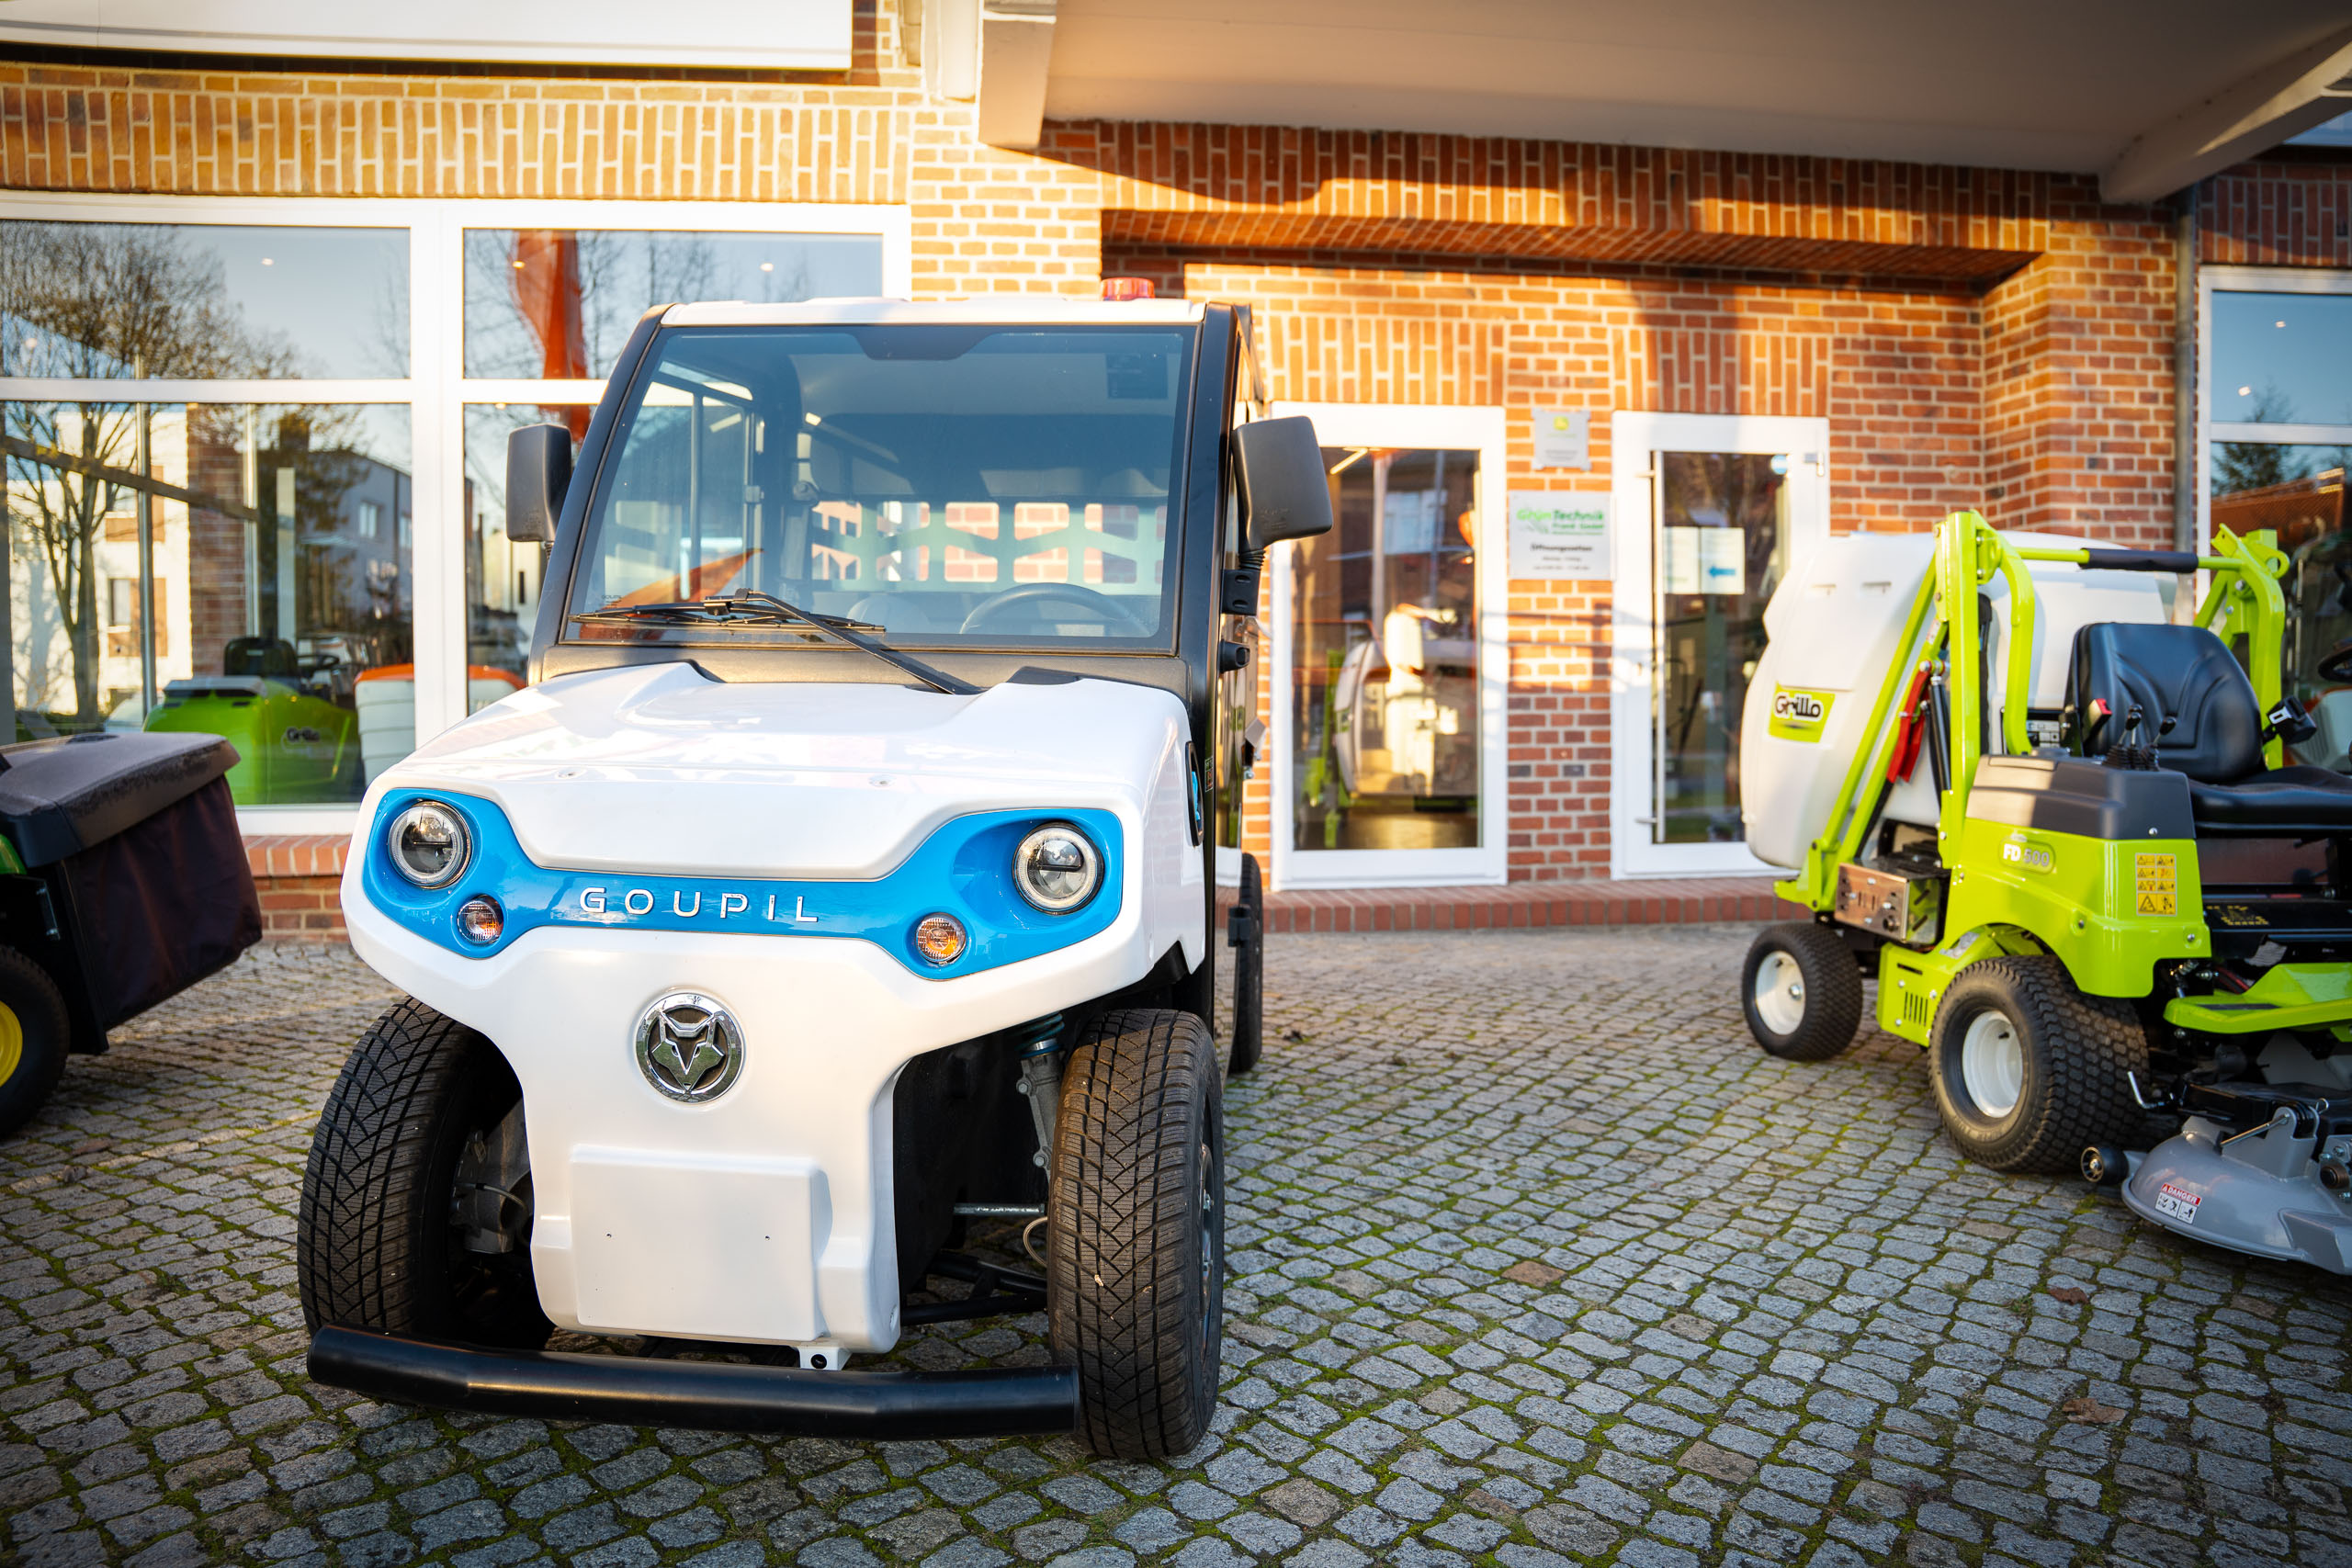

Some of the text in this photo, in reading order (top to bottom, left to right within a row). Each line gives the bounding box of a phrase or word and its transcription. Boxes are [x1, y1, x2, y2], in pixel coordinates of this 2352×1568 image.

[1776, 695, 1821, 717] Grillo
[2003, 843, 2050, 866] FD 500
[580, 886, 819, 922] GOUPIL
[2168, 1186, 2198, 1205] DANGER
